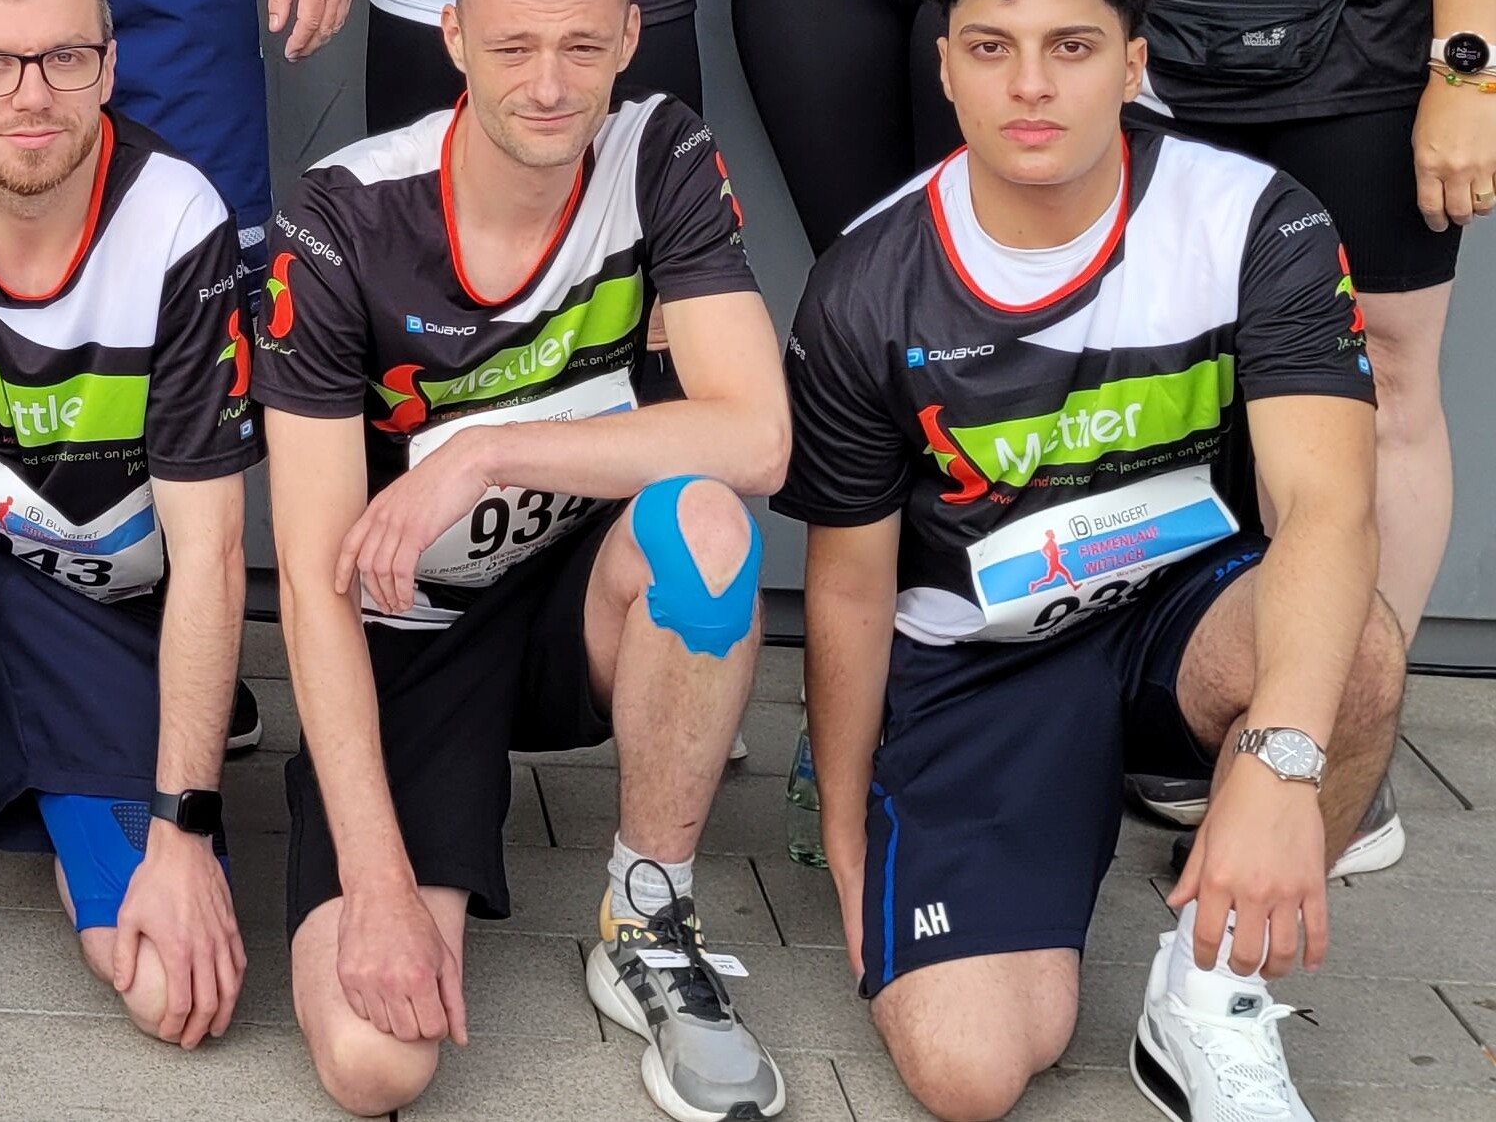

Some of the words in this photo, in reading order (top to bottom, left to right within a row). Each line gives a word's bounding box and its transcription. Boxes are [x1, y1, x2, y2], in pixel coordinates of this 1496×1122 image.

[1279, 210, 1330, 238] Racing
[298, 229, 343, 266] Eagles
[590, 357, 603, 365] an
[606, 341, 633, 362] jedem
[1177, 448, 1193, 457] an
[45, 518, 100, 539] BUNGERT
[468, 489, 596, 560] 934
[1094, 503, 1150, 530] BUNGERT
[1079, 525, 1159, 558] FIRMENLAUF
[1085, 548, 1145, 574] WITTLICH
[915, 902, 950, 940] AH
